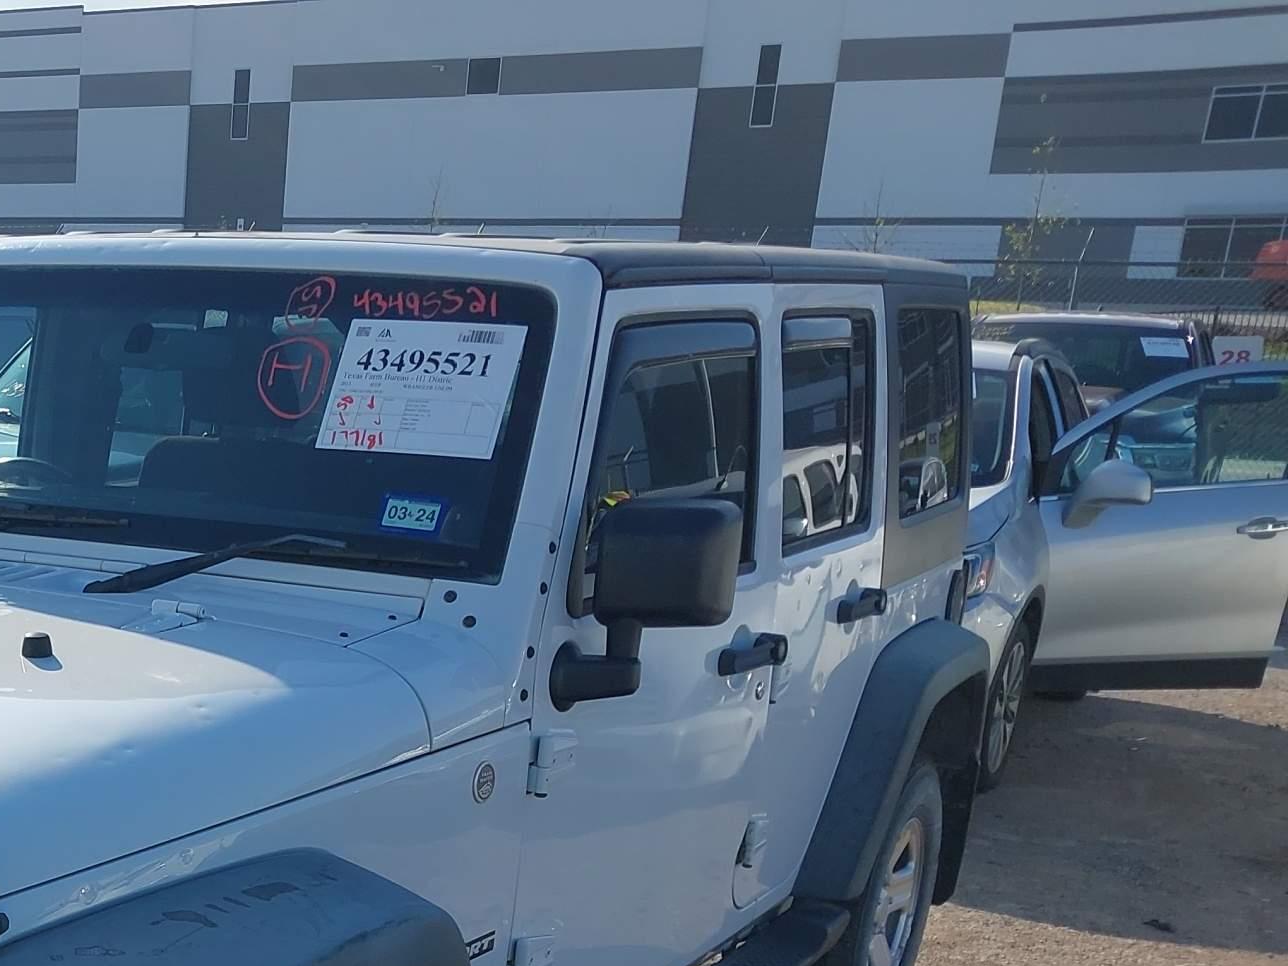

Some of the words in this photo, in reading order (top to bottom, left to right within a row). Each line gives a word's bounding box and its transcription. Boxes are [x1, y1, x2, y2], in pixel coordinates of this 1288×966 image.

[353, 286, 498, 320] 43495521
[357, 348, 493, 378] 43495521
[1220, 350, 1251, 365] 28
[344, 372, 363, 380] Texas
[364, 372, 383, 381] Farm
